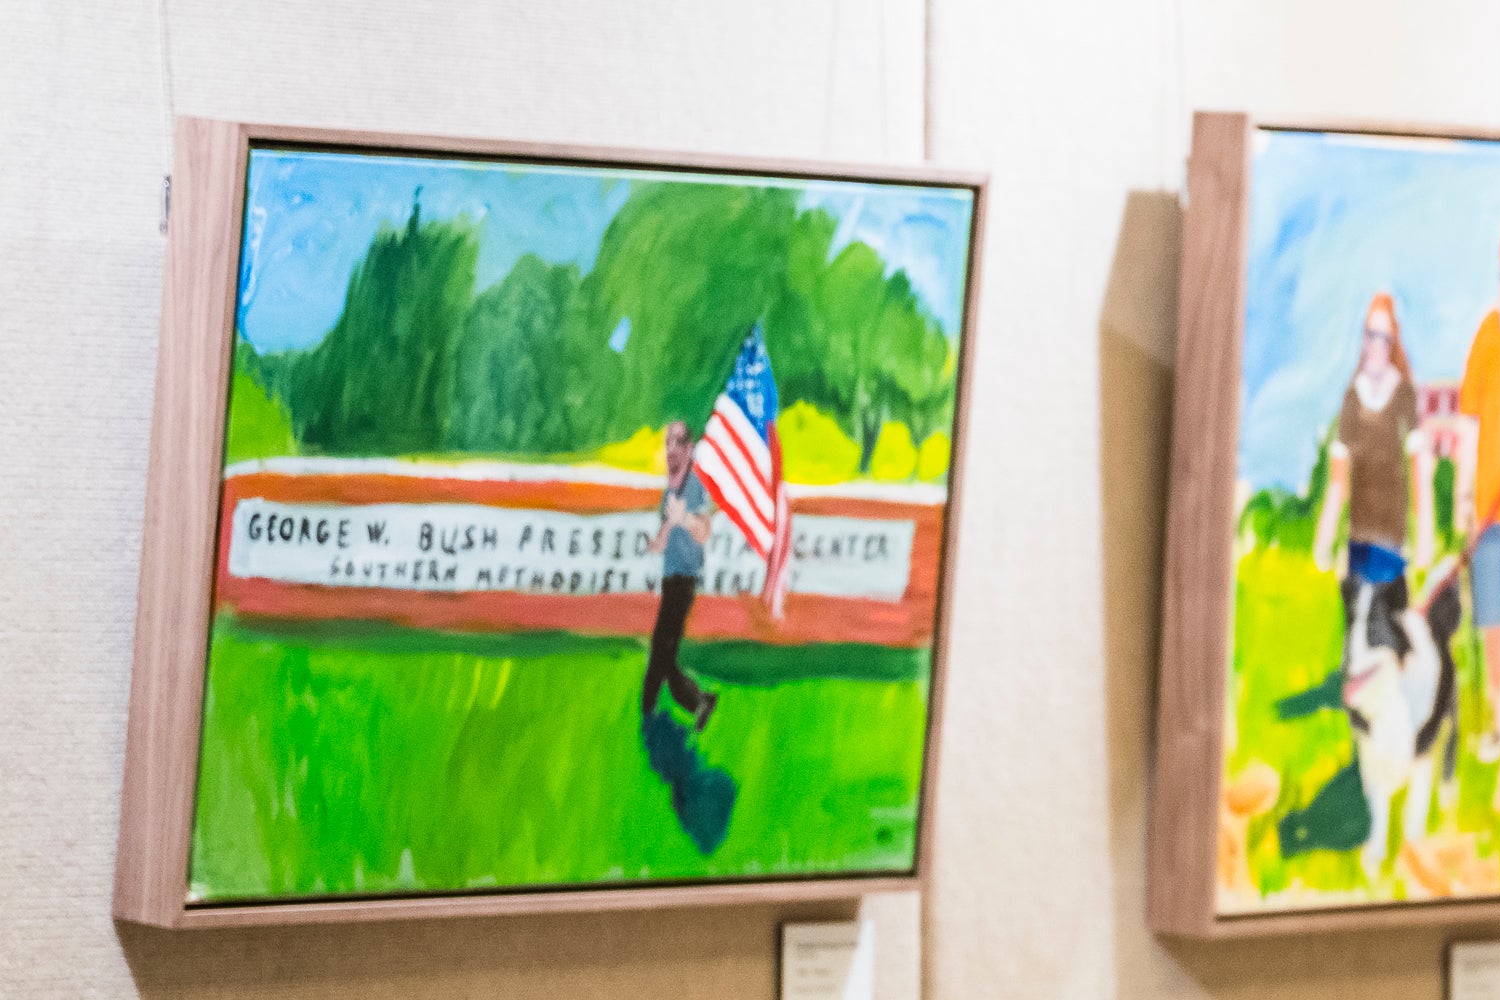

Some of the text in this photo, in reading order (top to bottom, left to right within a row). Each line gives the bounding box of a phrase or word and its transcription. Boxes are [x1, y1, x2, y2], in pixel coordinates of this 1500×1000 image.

[250, 512, 351, 548] GEORGE
[367, 520, 390, 545] W.
[419, 521, 498, 554] BUSH
[793, 533, 888, 561] CENTER
[330, 556, 457, 582] SOUTHERN
[477, 566, 629, 593] METHODIST
